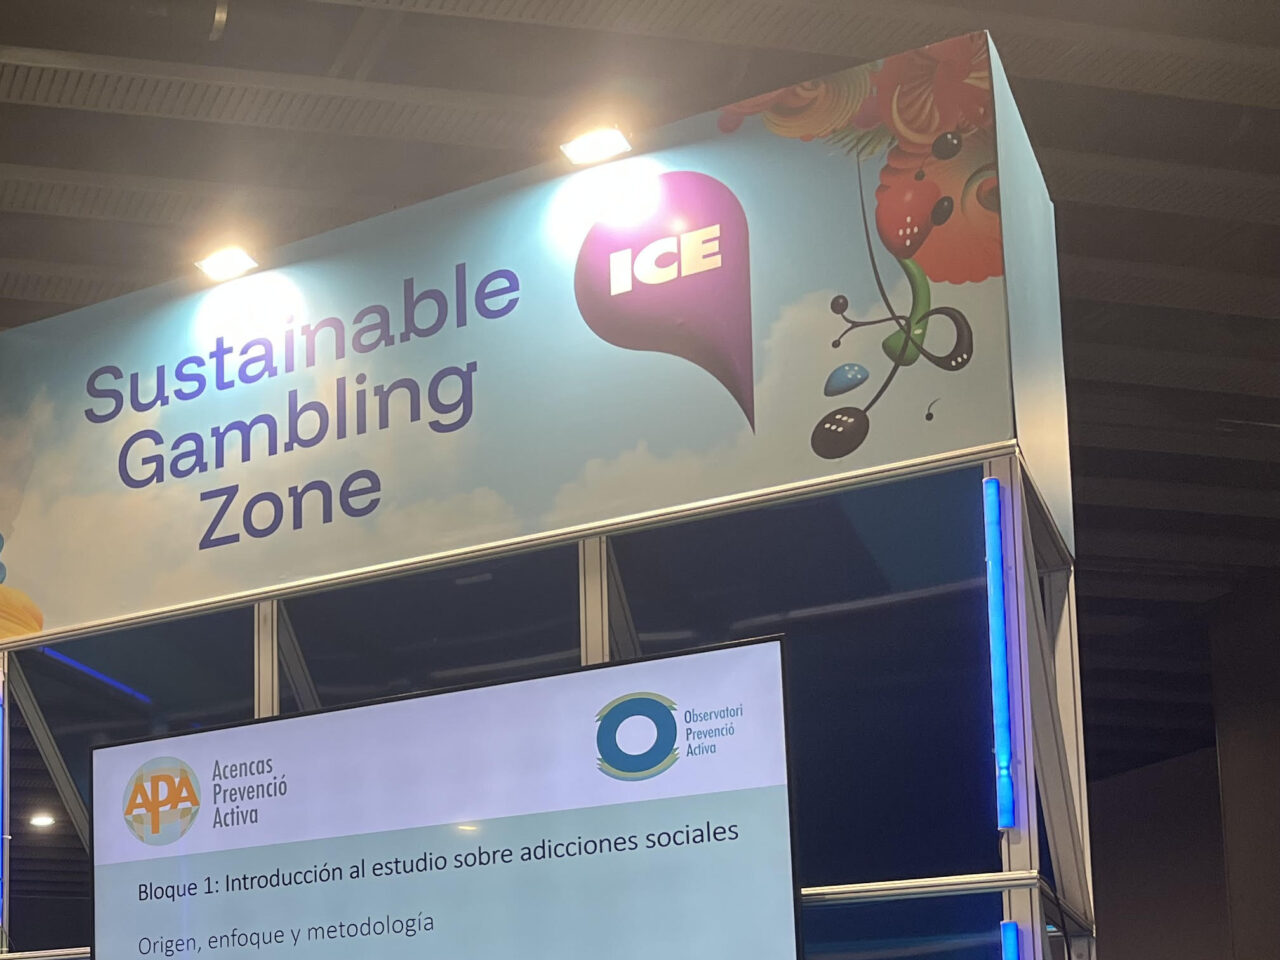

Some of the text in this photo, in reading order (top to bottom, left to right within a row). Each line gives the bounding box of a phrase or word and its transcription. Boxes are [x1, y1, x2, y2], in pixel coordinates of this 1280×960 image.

[609, 224, 722, 296] ICE
[84, 262, 520, 425] Sustainable
[118, 361, 478, 489] Gambling
[198, 467, 382, 551] Zone
[684, 703, 743, 724] Observatori
[685, 721, 735, 741] Prevenció
[212, 758, 273, 781] Acencas
[686, 742, 717, 757] Activa
[124, 774, 200, 834] APA
[213, 774, 288, 805] Prevenció
[212, 804, 259, 829] Activa
[138, 821, 739, 902] Bloque 1: Introducción al estudio sobre adicciones sociales
[138, 912, 435, 957] Origen, enfoque y metodología
